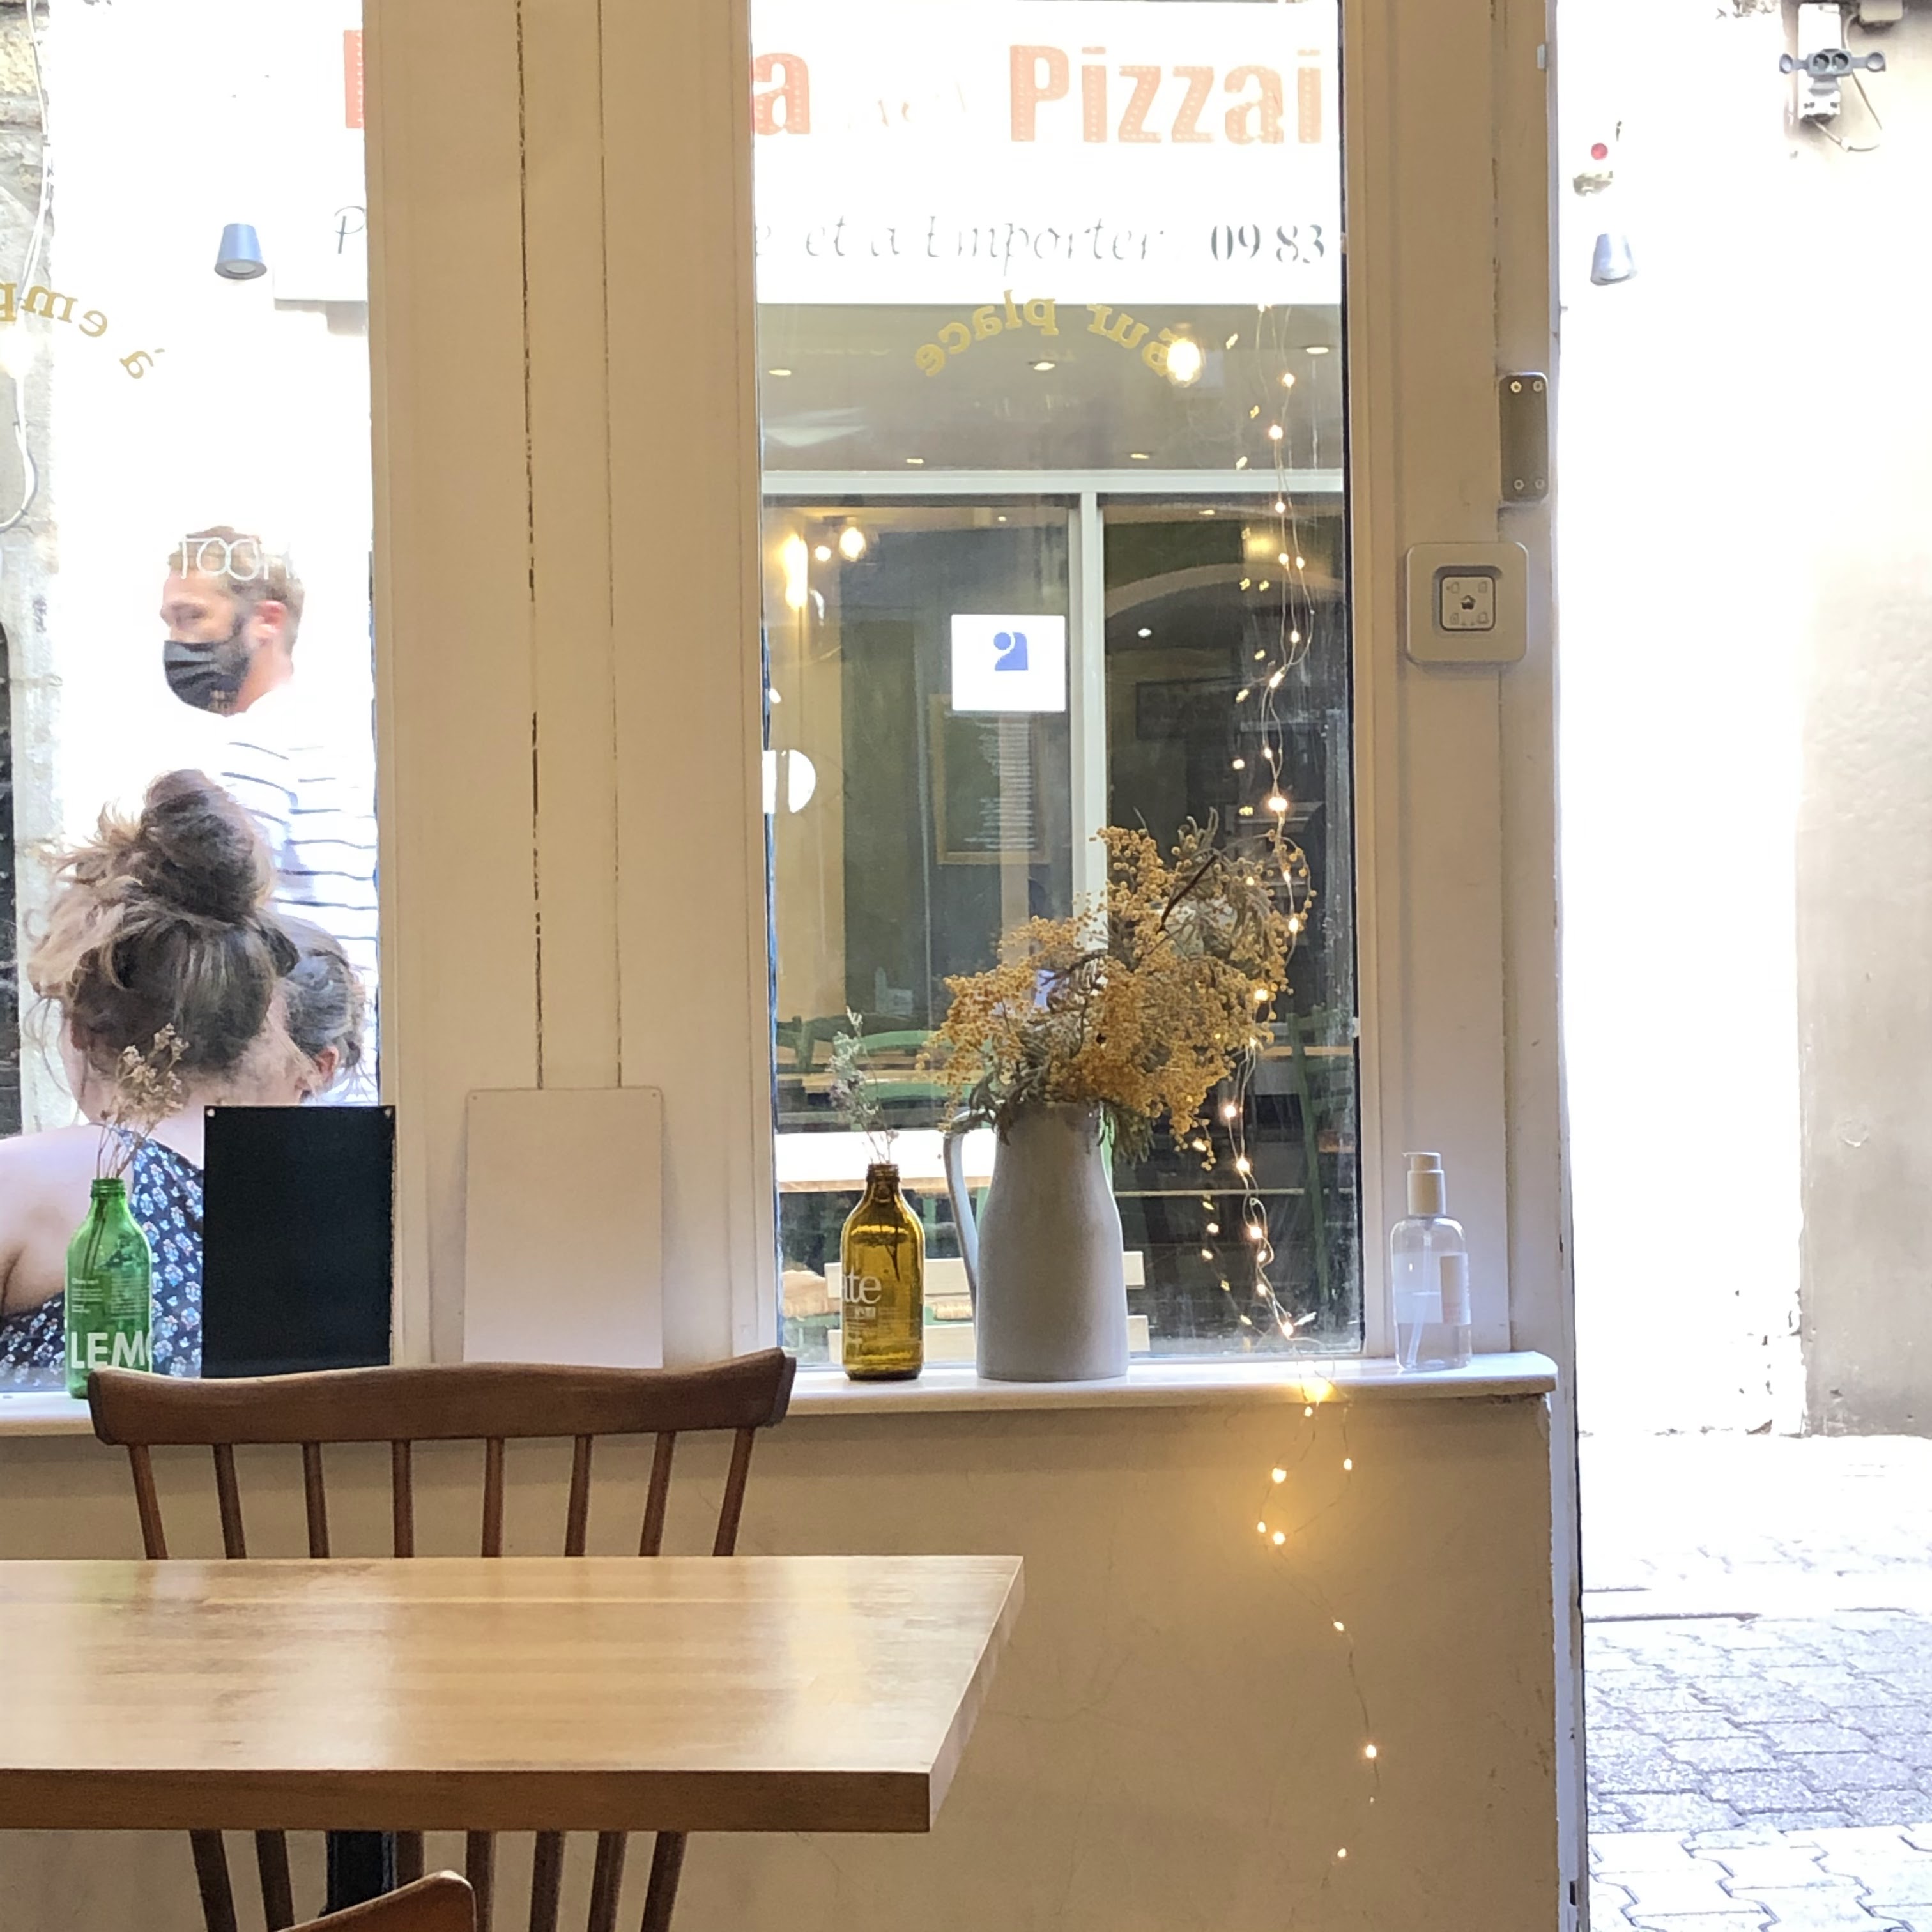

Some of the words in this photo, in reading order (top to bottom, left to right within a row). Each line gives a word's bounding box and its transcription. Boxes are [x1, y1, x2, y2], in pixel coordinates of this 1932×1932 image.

[1009, 44, 1322, 146] Pizzai
[1210, 224, 1261, 261] 09
[1275, 224, 1325, 264] 83
